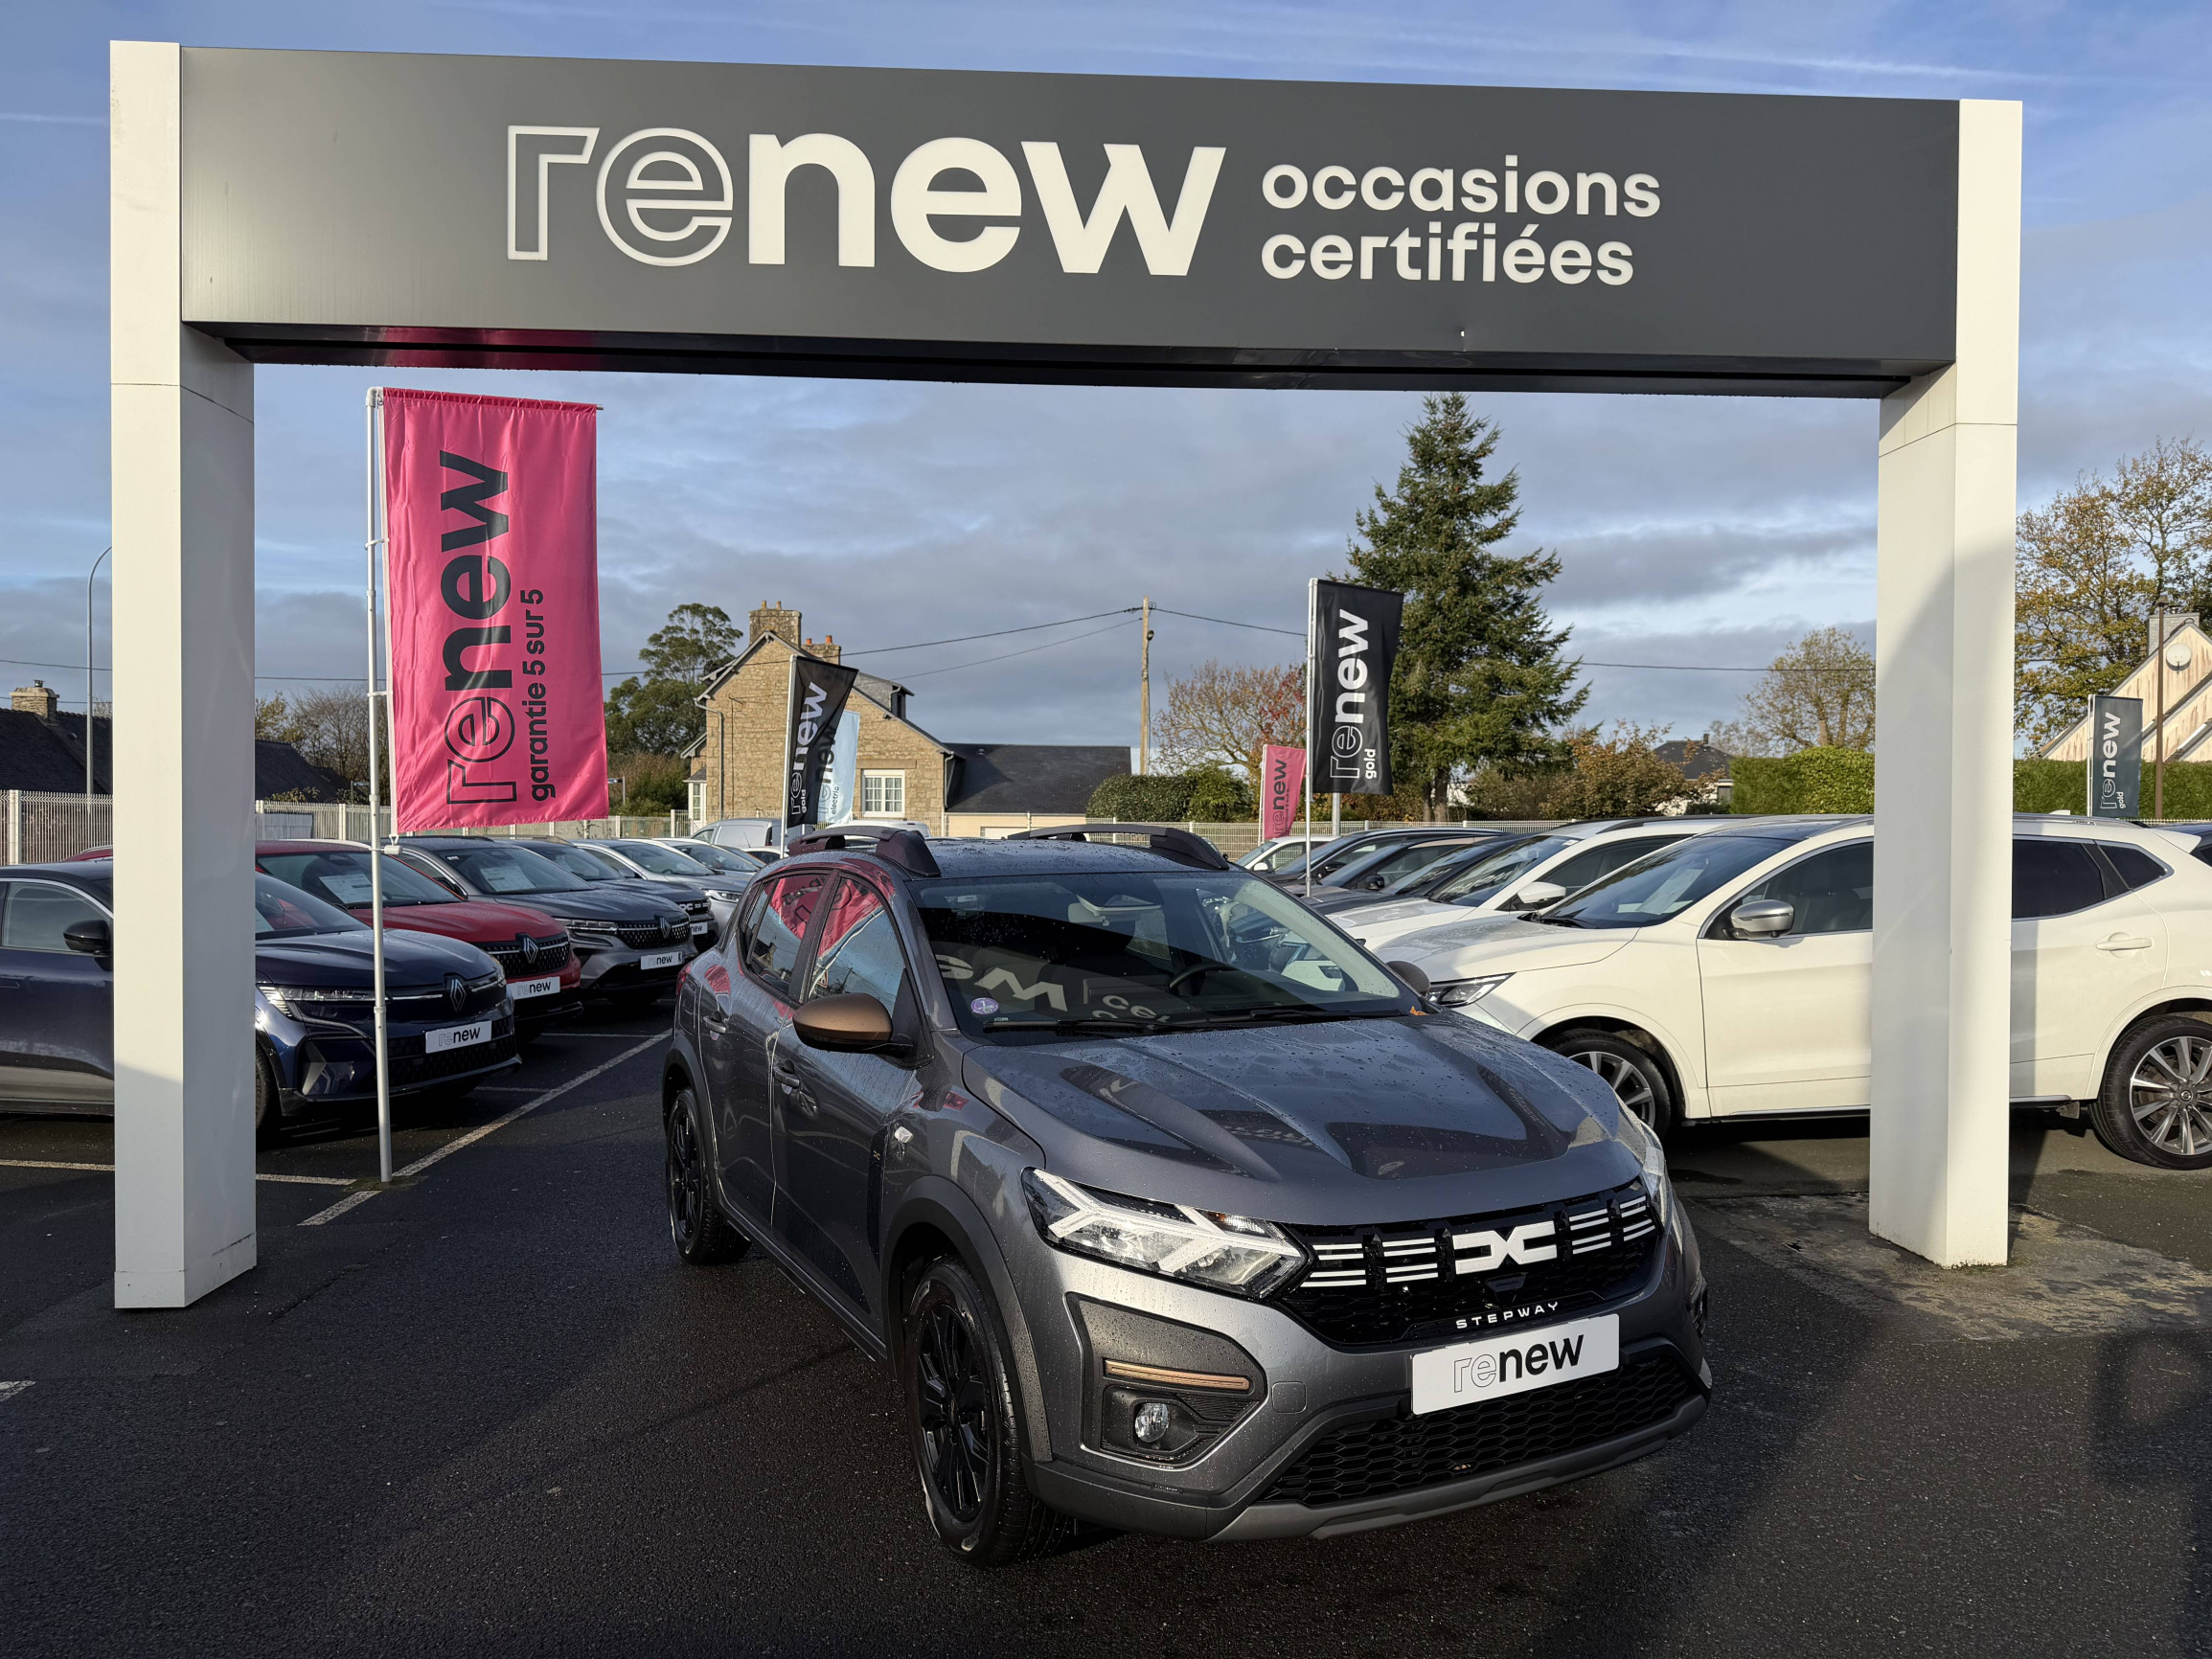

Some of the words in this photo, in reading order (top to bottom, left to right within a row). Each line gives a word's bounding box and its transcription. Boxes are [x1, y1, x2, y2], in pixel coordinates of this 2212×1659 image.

[507, 125, 1227, 277] renew
[1262, 155, 1662, 218] occasions
[1262, 221, 1634, 286] certifiées
[439, 449, 517, 805] renew
[520, 588, 544, 605] 5
[525, 609, 546, 655] sur
[522, 660, 546, 676] 5
[1330, 608, 1369, 779] renew
[521, 682, 556, 803] garantie
[790, 681, 828, 815] renew
[1364, 748, 1378, 780] gold
[2100, 712, 2121, 809] renew
[830, 785, 840, 815] electric
[1272, 759, 1288, 836] renew
[2115, 791, 2126, 809] gold
[516, 978, 552, 997] renew
[437, 1025, 481, 1046] renew
[1456, 1301, 1560, 1329] STEPWAY
[1452, 1334, 1585, 1395] renew
